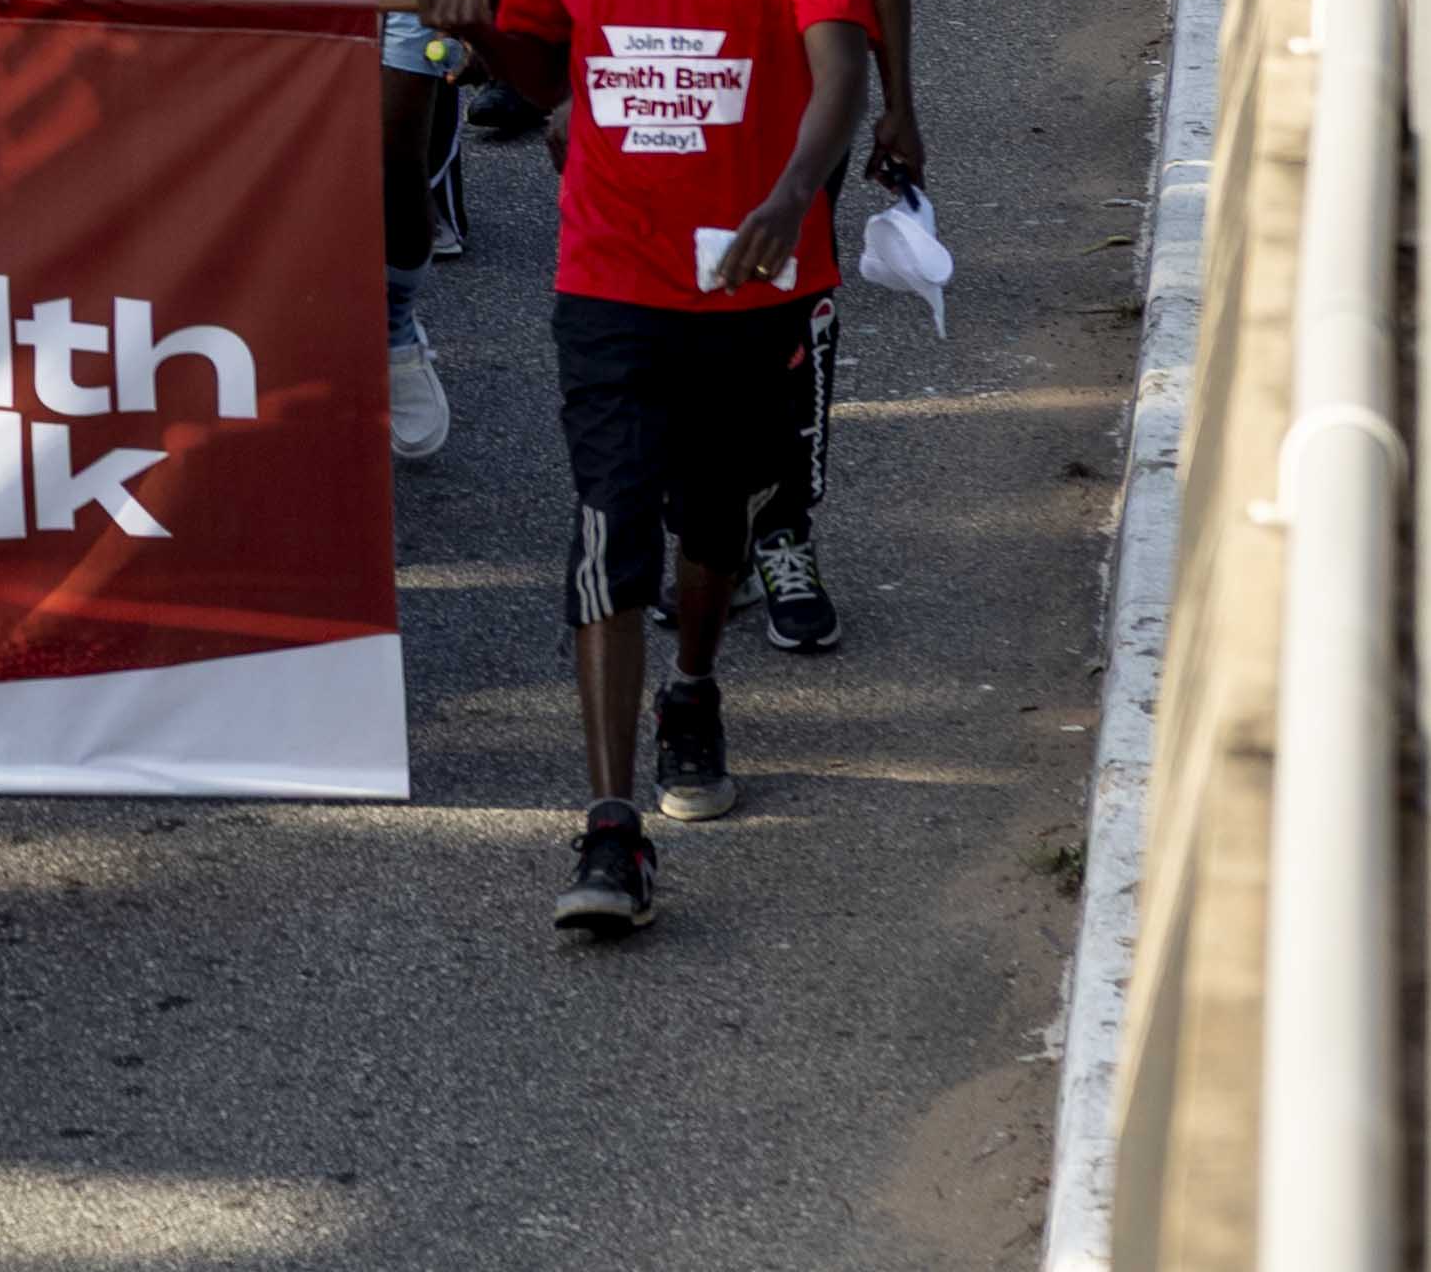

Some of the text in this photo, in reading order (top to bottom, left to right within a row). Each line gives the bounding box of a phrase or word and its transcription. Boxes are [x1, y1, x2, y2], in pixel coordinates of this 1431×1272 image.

[622, 32, 705, 53] Join the
[592, 66, 743, 92] Zenith Bank
[622, 95, 715, 123] Family
[631, 130, 699, 151] today!
